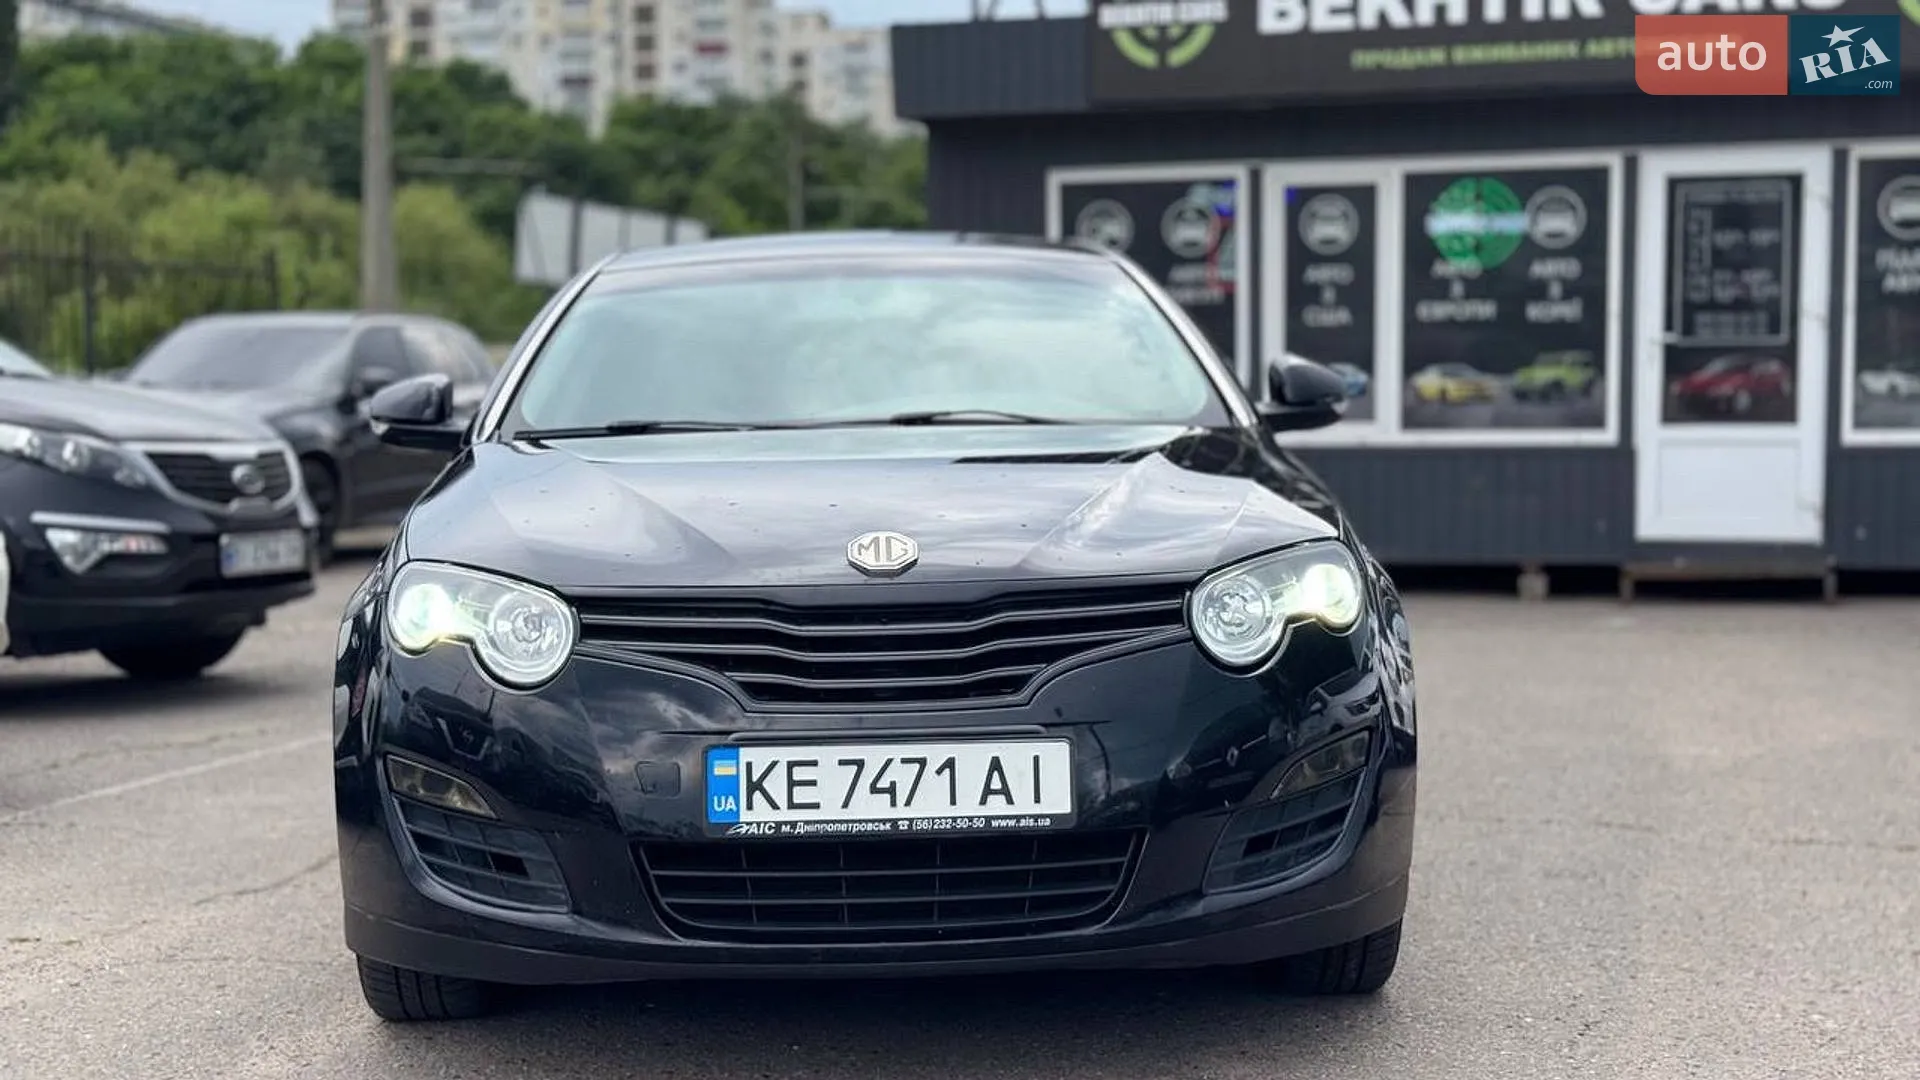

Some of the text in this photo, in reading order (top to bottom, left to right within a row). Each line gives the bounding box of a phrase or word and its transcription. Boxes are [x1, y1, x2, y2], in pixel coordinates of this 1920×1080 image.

[858, 536, 908, 562] MG
[746, 760, 820, 811] KE
[838, 756, 957, 809] 7471
[714, 795, 738, 813] UA
[991, 816, 1051, 828] www.ais.ua
